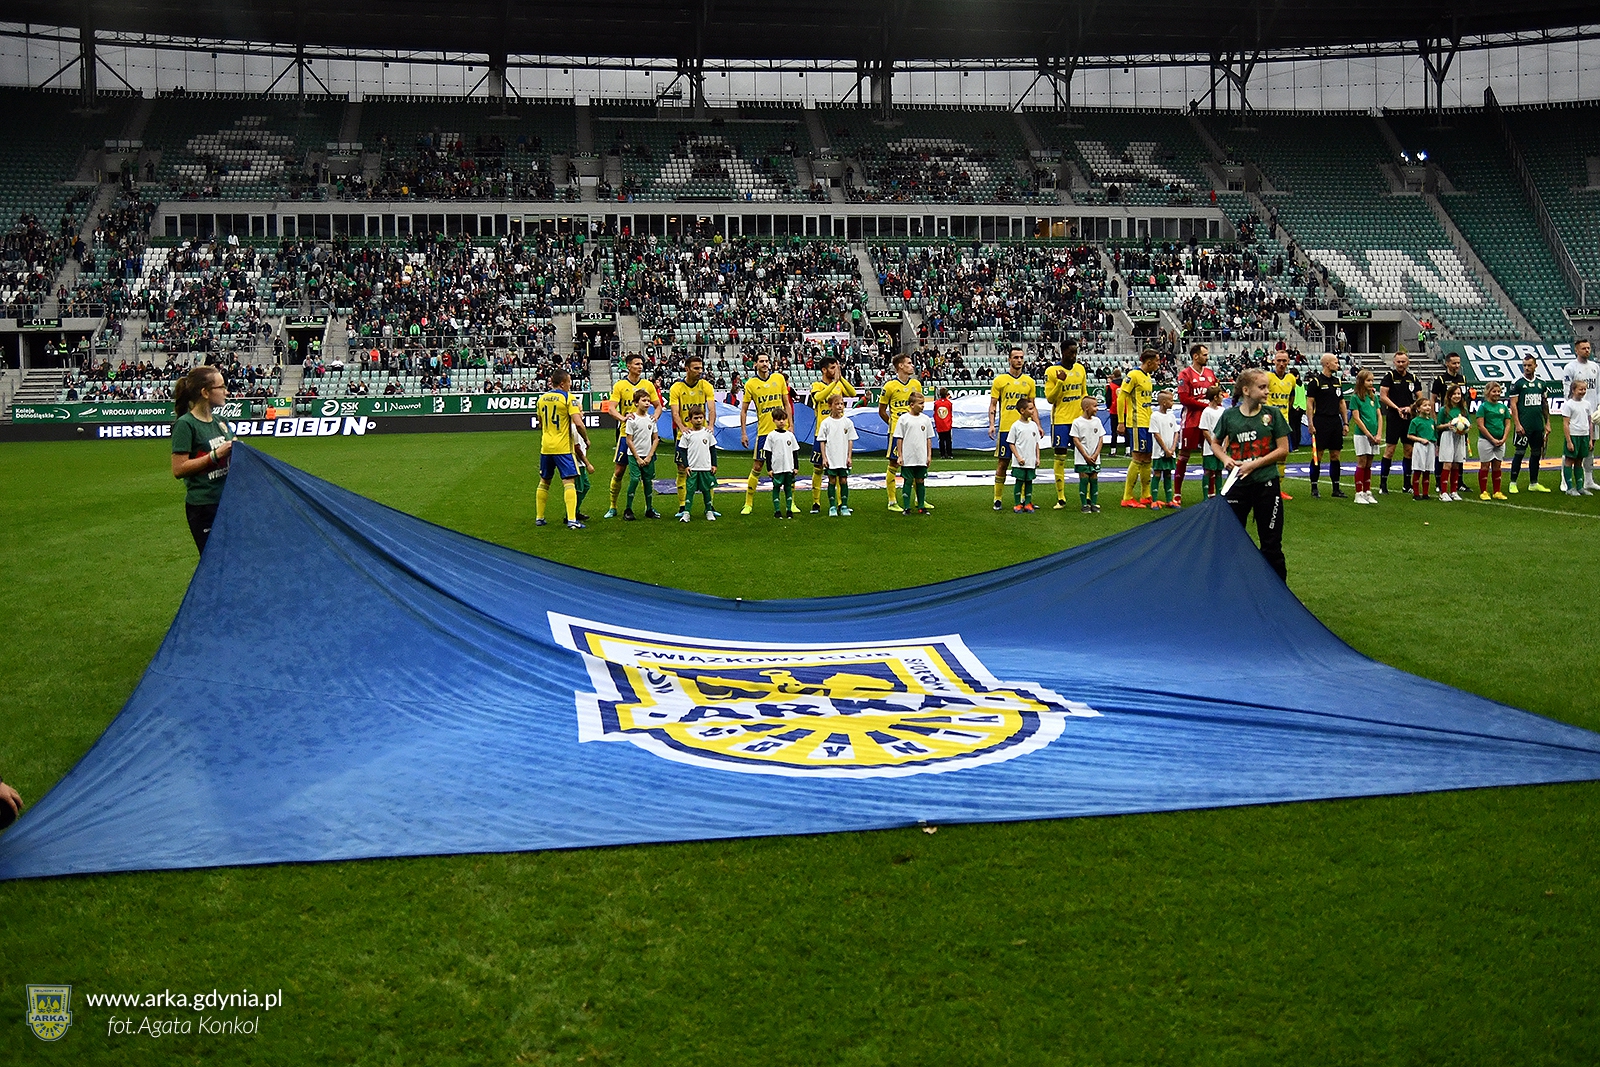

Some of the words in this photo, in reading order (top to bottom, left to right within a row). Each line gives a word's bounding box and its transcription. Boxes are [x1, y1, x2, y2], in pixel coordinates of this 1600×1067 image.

[1464, 344, 1577, 361] NOBLE
[274, 399, 286, 407] 13
[340, 402, 359, 411] SSK
[389, 402, 422, 412] Nawrot
[486, 397, 537, 410] NOBLE
[542, 405, 560, 430] 14
[99, 424, 172, 438] HERSKIE
[1236, 430, 1257, 443] WKS
[1055, 435, 1061, 446] 3
[1183, 438, 1188, 447] 1
[618, 451, 625, 462] 7
[810, 451, 821, 462] 77
[1000, 445, 1006, 457] 9
[678, 694, 977, 723] ARKA
